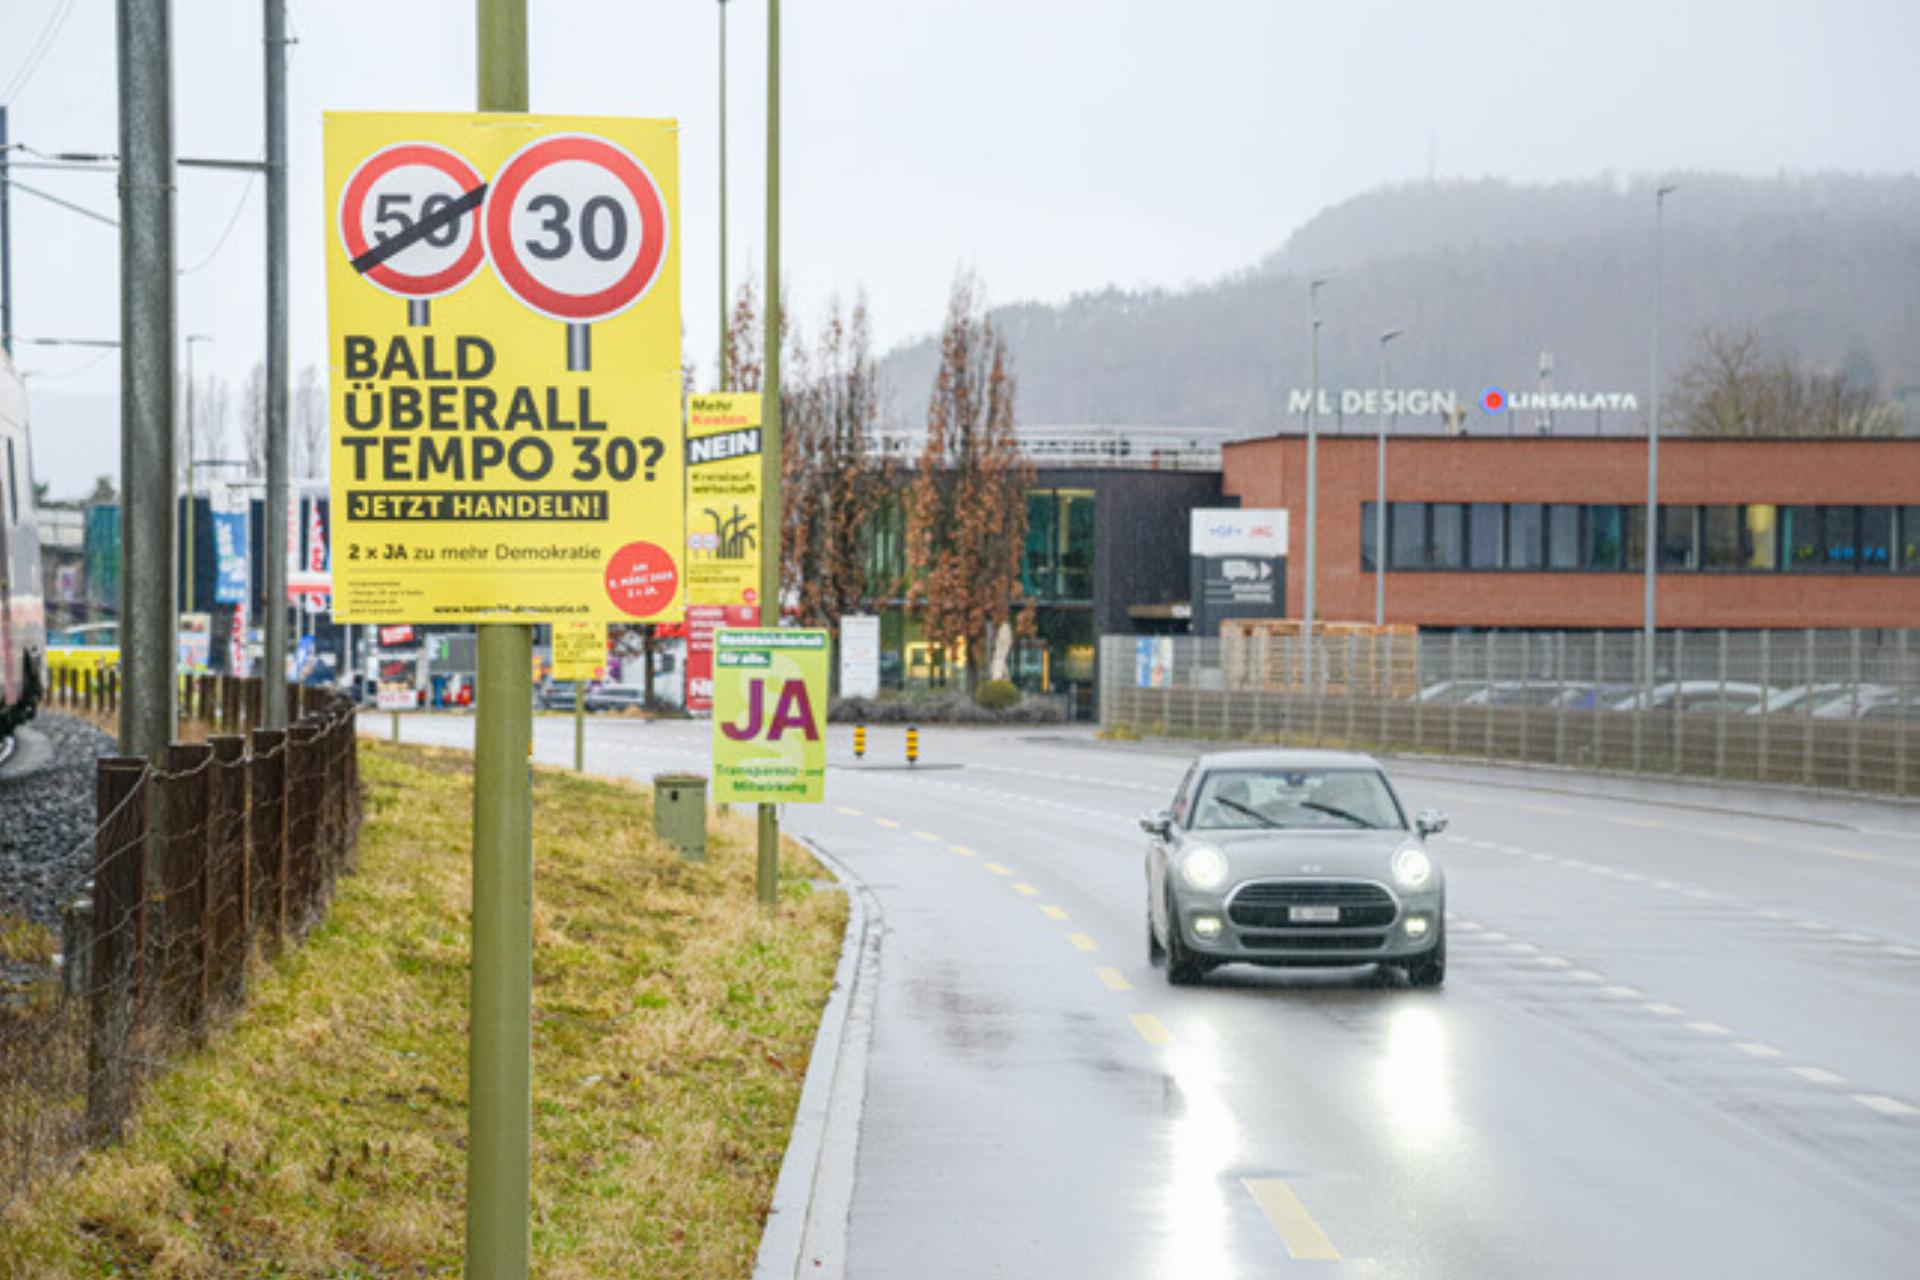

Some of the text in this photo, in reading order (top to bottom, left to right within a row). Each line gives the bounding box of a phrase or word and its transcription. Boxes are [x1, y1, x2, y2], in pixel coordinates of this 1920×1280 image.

[373, 194, 462, 249] 50
[525, 194, 629, 262] 30
[344, 335, 496, 381] BALD
[344, 382, 608, 432] ÜBERALL
[1340, 389, 1457, 415] DESIGN
[1507, 392, 1639, 410] LINSALATA
[341, 436, 666, 481] TEMPO 30?
[691, 428, 757, 463] NEIN
[353, 495, 601, 519] JETZT HANDELN!
[348, 543, 360, 560] 2
[383, 543, 408, 560] JA
[413, 548, 435, 560] zu
[441, 544, 488, 560] mehr
[495, 543, 601, 560] Demokratie
[719, 678, 820, 741] JA
